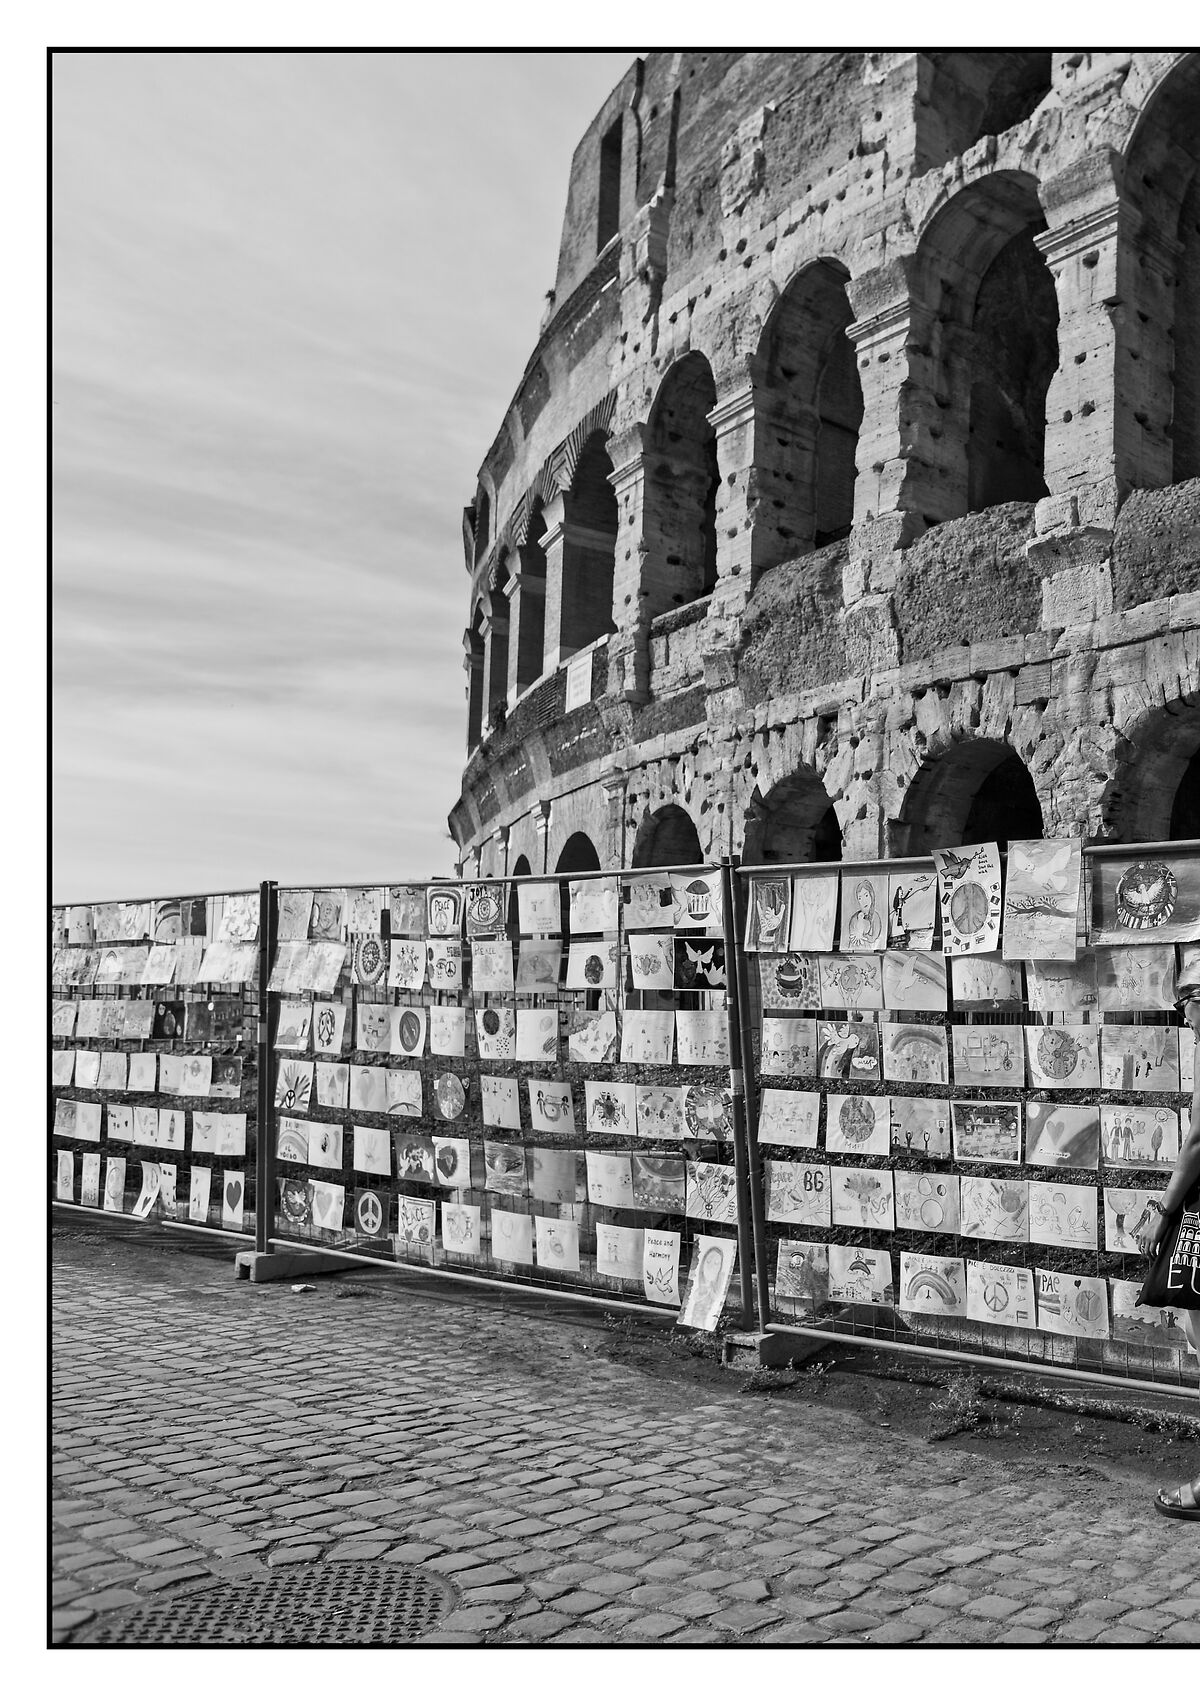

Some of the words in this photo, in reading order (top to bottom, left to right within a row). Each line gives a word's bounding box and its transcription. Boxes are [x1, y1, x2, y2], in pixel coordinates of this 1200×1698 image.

[803, 1170, 824, 1193] BG
[647, 1236, 662, 1246] Peace
[663, 1239, 674, 1247] and
